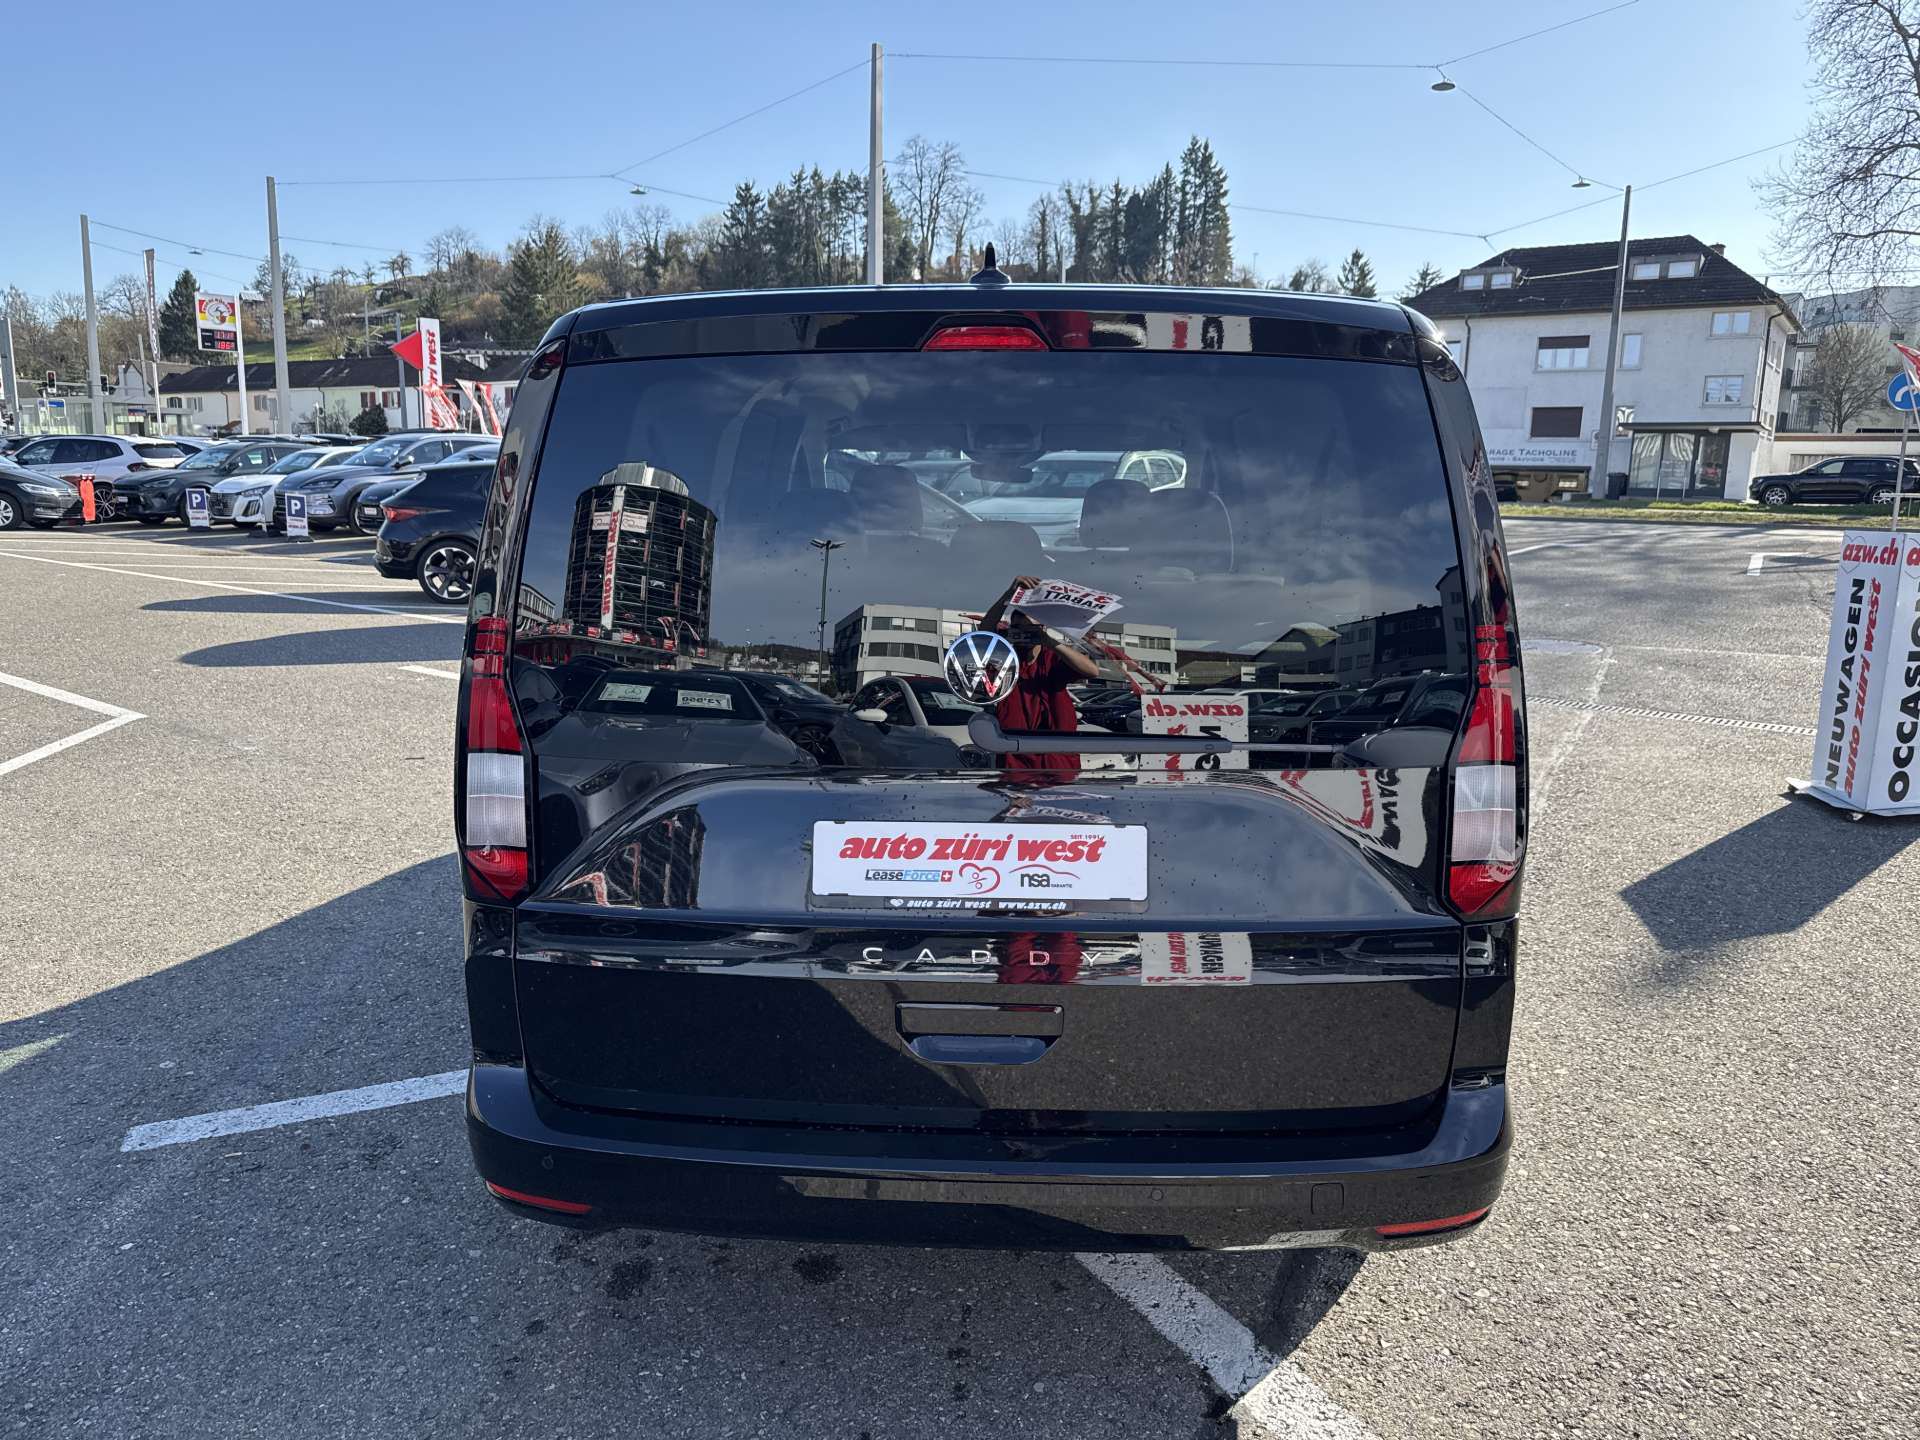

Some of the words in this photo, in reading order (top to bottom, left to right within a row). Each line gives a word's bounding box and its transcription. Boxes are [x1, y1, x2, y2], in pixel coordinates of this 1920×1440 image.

[426, 328, 437, 366] west
[1489, 448, 1516, 456] RAGE
[1518, 448, 1578, 457] TACHOLINE
[1842, 537, 1899, 566] azw.ch
[1824, 578, 1866, 791] NEUWAGEN
[1844, 725, 1861, 799] auto
[1854, 653, 1871, 726] züri
[1863, 576, 1882, 652] west
[839, 832, 928, 860] auto
[927, 832, 1014, 862] züri
[1017, 836, 1107, 863] west
[864, 868, 940, 882] LeaseForce
[1020, 873, 1051, 888] nsa
[906, 899, 933, 909] auto
[935, 898, 961, 909] züri
[964, 899, 992, 910] west
[998, 900, 1067, 911] www.azw.ch
[862, 946, 1102, 967] CADDY
